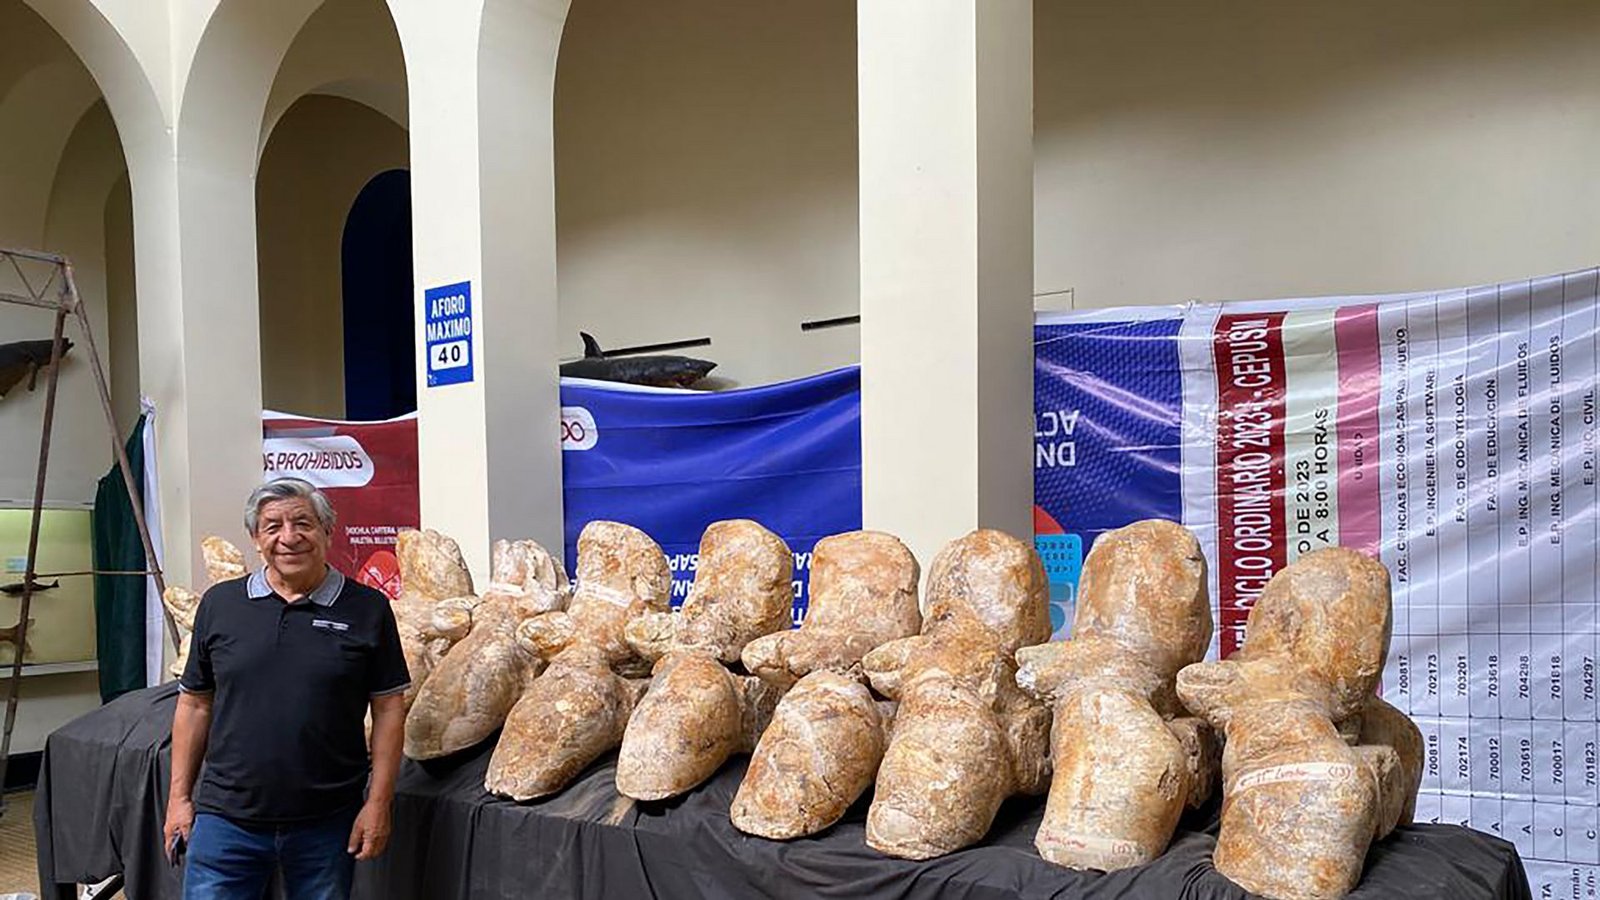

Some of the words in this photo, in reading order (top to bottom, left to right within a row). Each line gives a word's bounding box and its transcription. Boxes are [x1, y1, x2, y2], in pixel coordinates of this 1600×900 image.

[430, 294, 466, 319] AFORO
[427, 317, 471, 342] MAXIMO
[438, 345, 461, 364] 40
[1517, 342, 1528, 397] FLUIDOS
[1550, 335, 1560, 392] LUIDOS
[1452, 374, 1465, 469] ODONTOLOGÍA
[1484, 379, 1496, 457] EDUCACIÓN
[1550, 396, 1560, 414] DE
[1583, 390, 1594, 425] CIVIL
[276, 451, 363, 471] PROHIBIDOS
[1314, 409, 1329, 475] HORAS
[1296, 460, 1310, 502] 2023
[1424, 437, 1435, 510] INGENIERÍA
[1456, 472, 1466, 490] DE
[1486, 460, 1496, 478] DE
[1232, 453, 1274, 551] ORDINARIO
[1297, 508, 1310, 534] DE
[1315, 480, 1329, 520] 8:00
[1316, 529, 1329, 543] A
[1234, 556, 1273, 609] CICLO
[1397, 554, 1407, 583] FAC.
[1399, 655, 1408, 696] 700817
[1428, 654, 1437, 696] 702173
[1458, 655, 1467, 697] 703201
[1488, 655, 1498, 698] 703618
[1583, 656, 1593, 701] 704297
[1428, 735, 1438, 777] 700818
[1458, 736, 1467, 779] 702174
[1489, 738, 1499, 780] 700012
[1521, 739, 1530, 783] 703619
[1552, 741, 1562, 784] 700017
[1585, 742, 1595, 787] 701823
[1491, 822, 1500, 832] A
[1521, 824, 1531, 835] A
[1553, 827, 1563, 837] C
[1586, 830, 1596, 840] C
